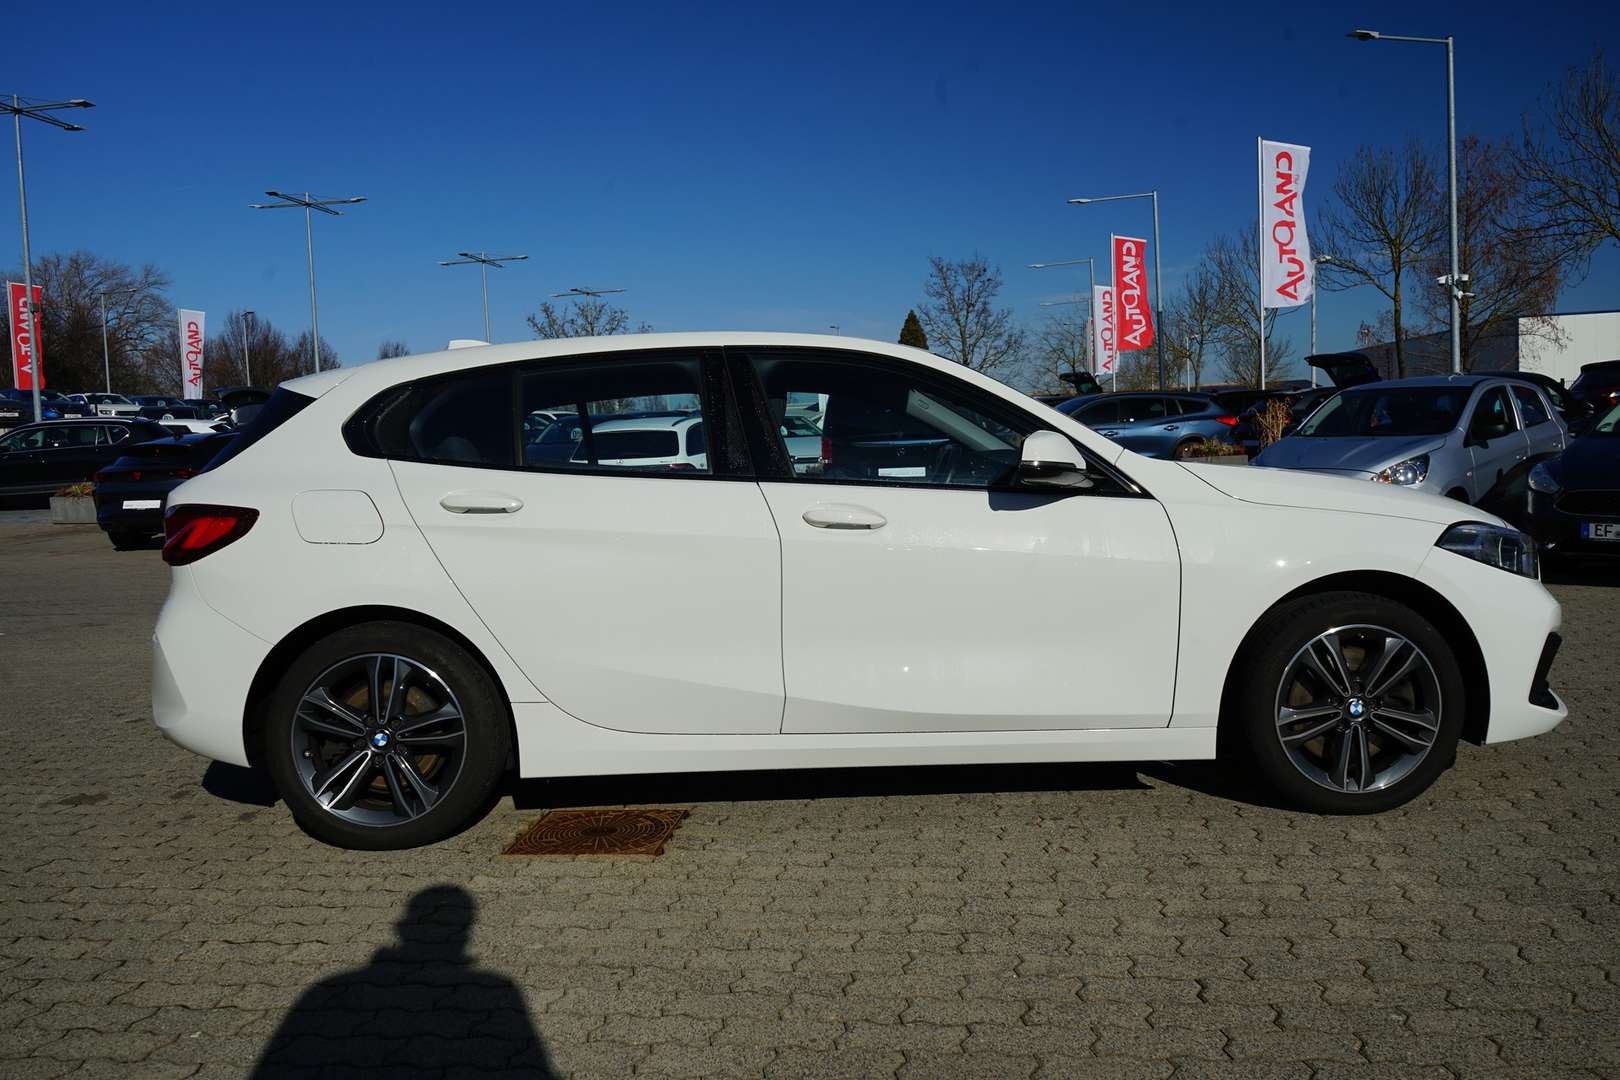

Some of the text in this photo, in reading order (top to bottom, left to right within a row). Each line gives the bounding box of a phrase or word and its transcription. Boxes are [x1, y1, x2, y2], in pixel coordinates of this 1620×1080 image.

[1273, 151, 1306, 300] AUTOLAND
[1122, 241, 1147, 346] AUTOLAND
[186, 321, 202, 387] AUTOLAND
[1594, 524, 1613, 537] EF
